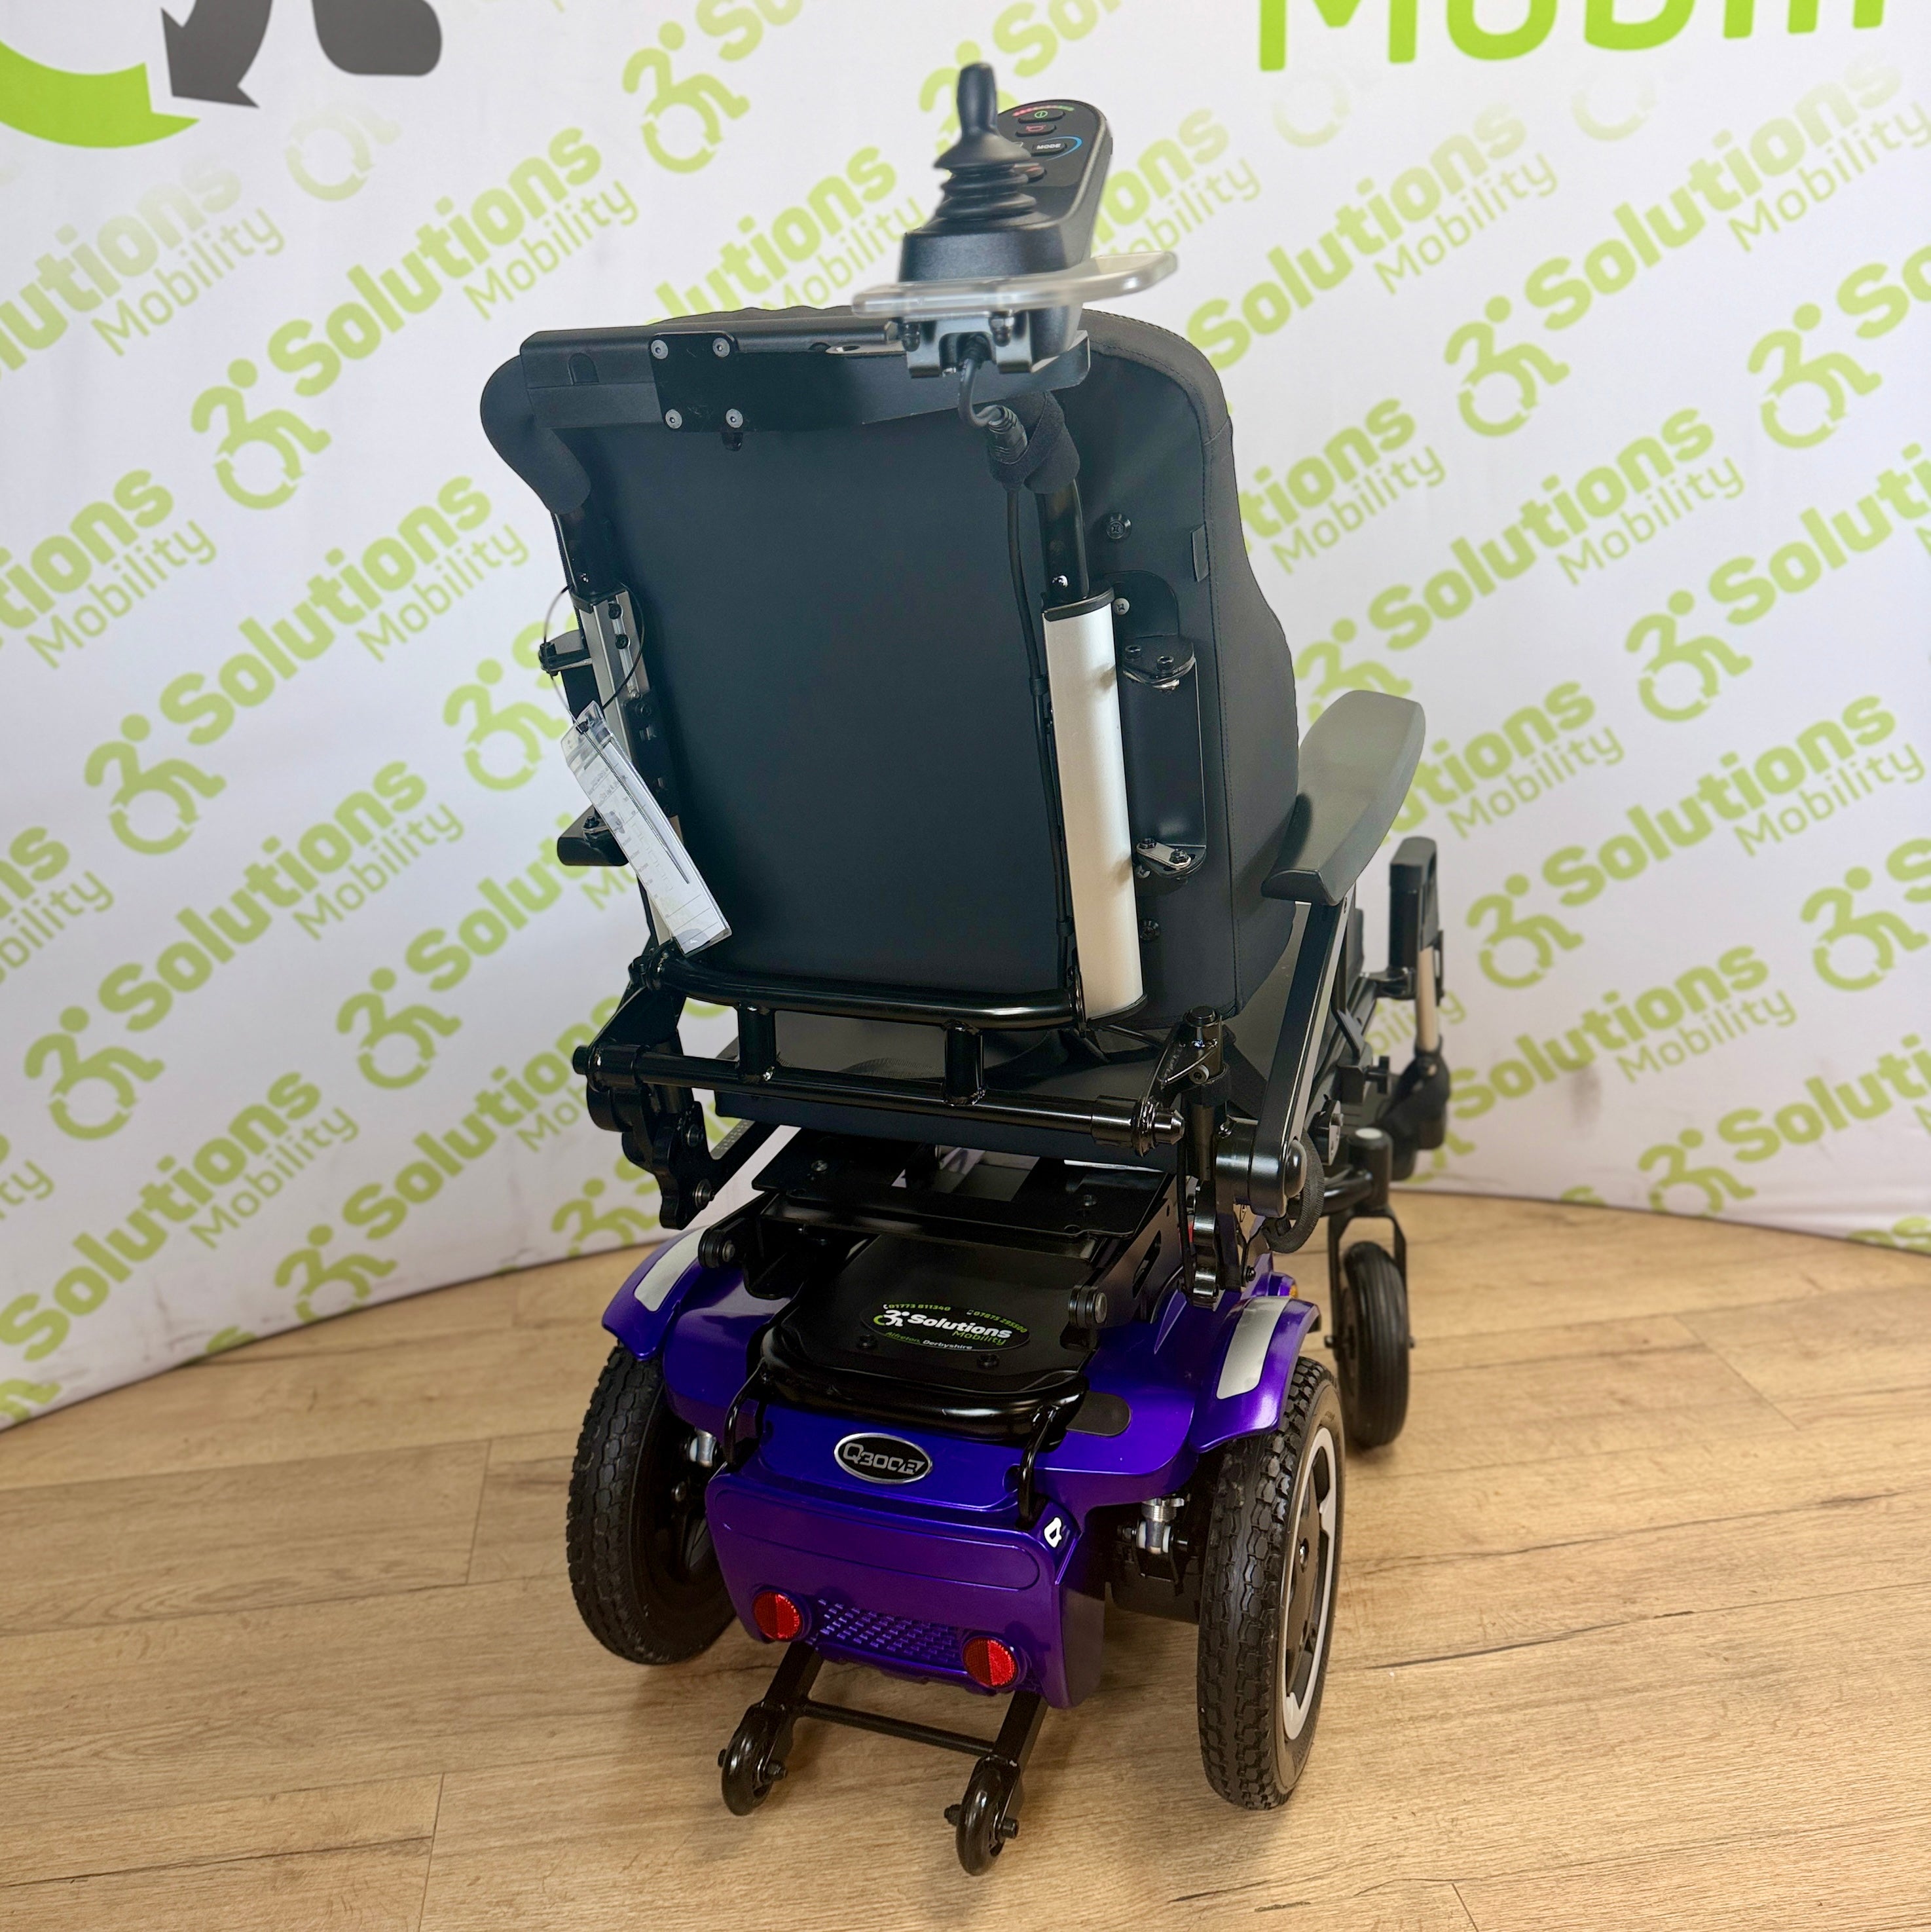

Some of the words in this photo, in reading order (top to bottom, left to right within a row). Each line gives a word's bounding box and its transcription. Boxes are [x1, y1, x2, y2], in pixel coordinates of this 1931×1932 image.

[1187, 103, 1527, 371] Solutions
[1371, 152, 1558, 294] Mobility
[1524, 47, 1903, 330] Solutions
[1727, 100, 1931, 253] Mobility
[90, 207, 285, 357] Mobility
[267, 127, 602, 397] Solutions
[462, 180, 638, 321] Mobility
[1270, 446, 1446, 574] Mobility
[1368, 407, 1714, 651] Solutions
[1556, 457, 1746, 585] Mobility
[26, 520, 217, 669] Mobility
[159, 475, 491, 745] Solutions
[356, 524, 529, 663] Mobility
[1447, 727, 1625, 839] Mobility
[1542, 696, 1896, 906] Solutions
[1734, 743, 1926, 857] Mobility
[98, 761, 427, 1031] Solutions
[293, 803, 464, 940] Mobility
[1449, 945, 1769, 1119] Solutions
[1615, 990, 1797, 1083] Mobility
[0, 1071, 321, 1362] Solutions
[189, 1107, 359, 1250] Mobility
[908, 1314, 1013, 1339] Solutions
[922, 1339, 973, 1350] Derbyshire
[951, 1330, 1007, 1346] Mobility
